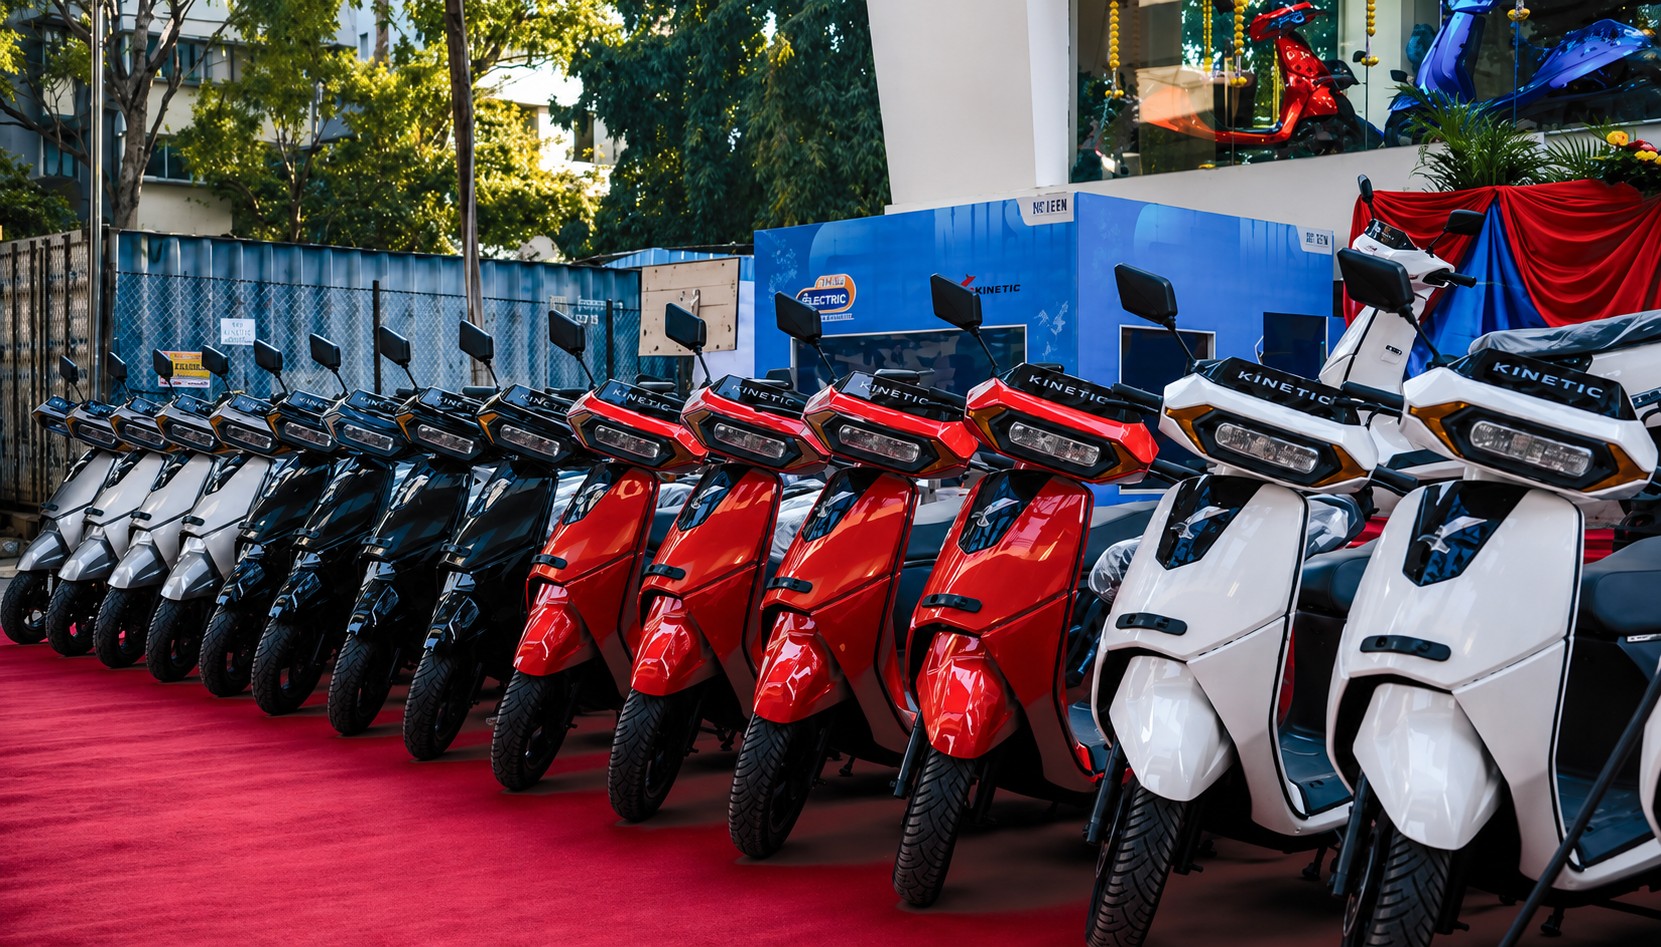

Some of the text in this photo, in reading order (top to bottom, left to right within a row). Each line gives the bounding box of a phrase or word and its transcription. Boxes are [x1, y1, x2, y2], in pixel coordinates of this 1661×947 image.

[974, 284, 1021, 295] KINETIC
[859, 380, 929, 405] KINETIC
[1028, 374, 1109, 405] KINETIC
[1238, 370, 1332, 405] KINETIC
[1493, 361, 1604, 399] KINETIC
[612, 388, 671, 412] KINETIC
[731, 384, 795, 407] KINETIC
